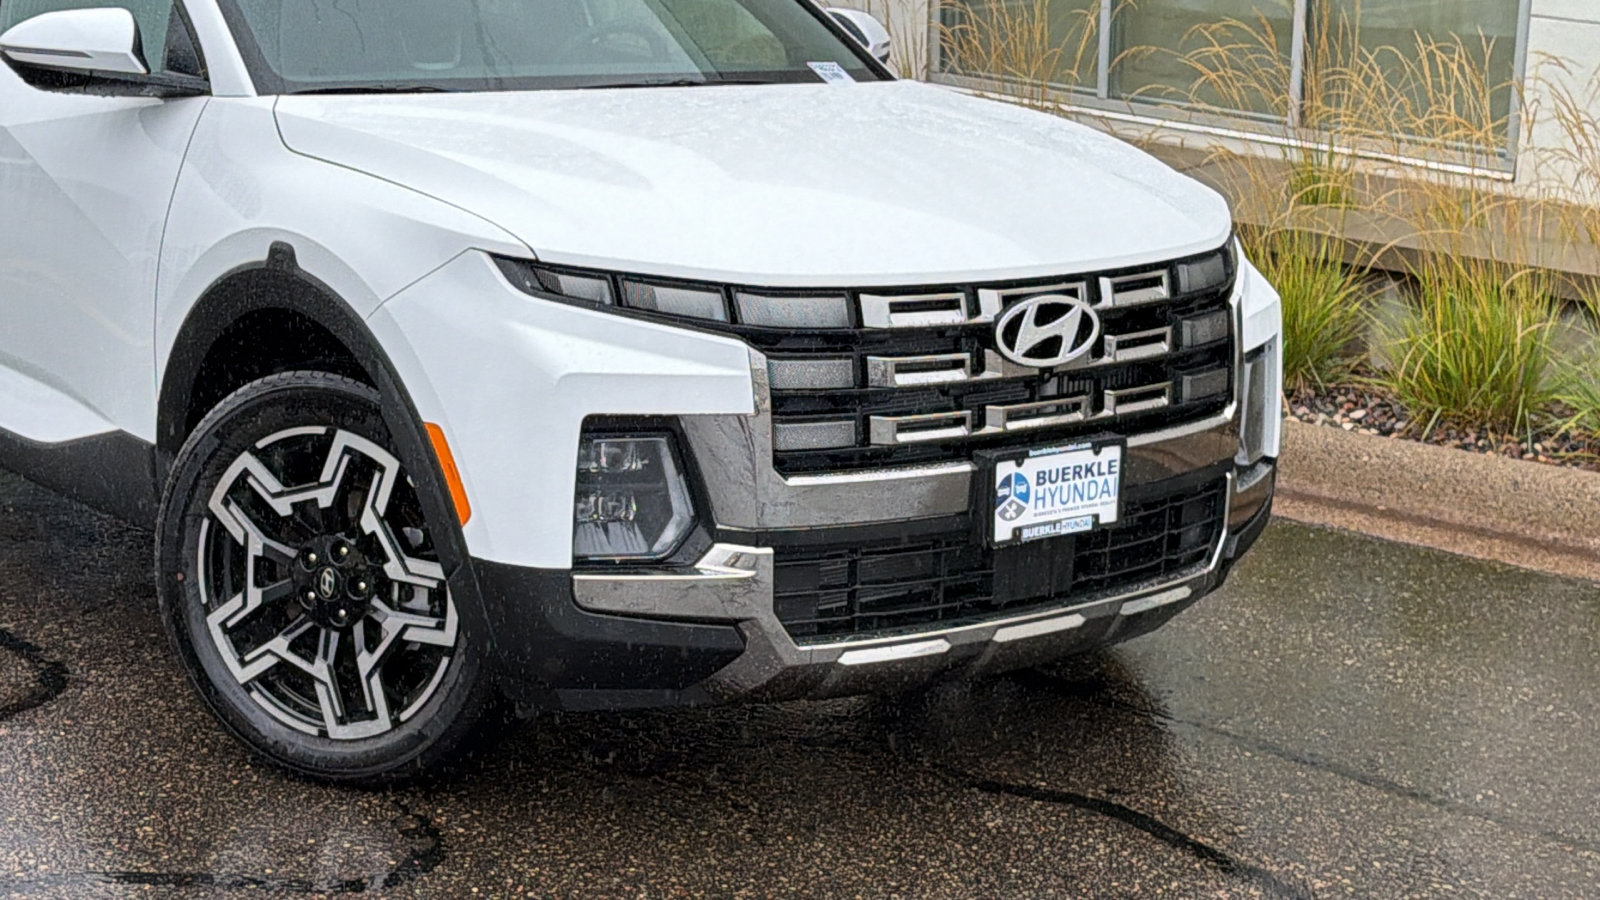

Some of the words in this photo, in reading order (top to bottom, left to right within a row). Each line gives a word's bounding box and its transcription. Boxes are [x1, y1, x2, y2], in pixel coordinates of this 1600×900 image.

[1036, 459, 1118, 486] BUERKLE
[1034, 476, 1117, 510] HYUNDAI
[1022, 523, 1061, 539] BUERKLE
